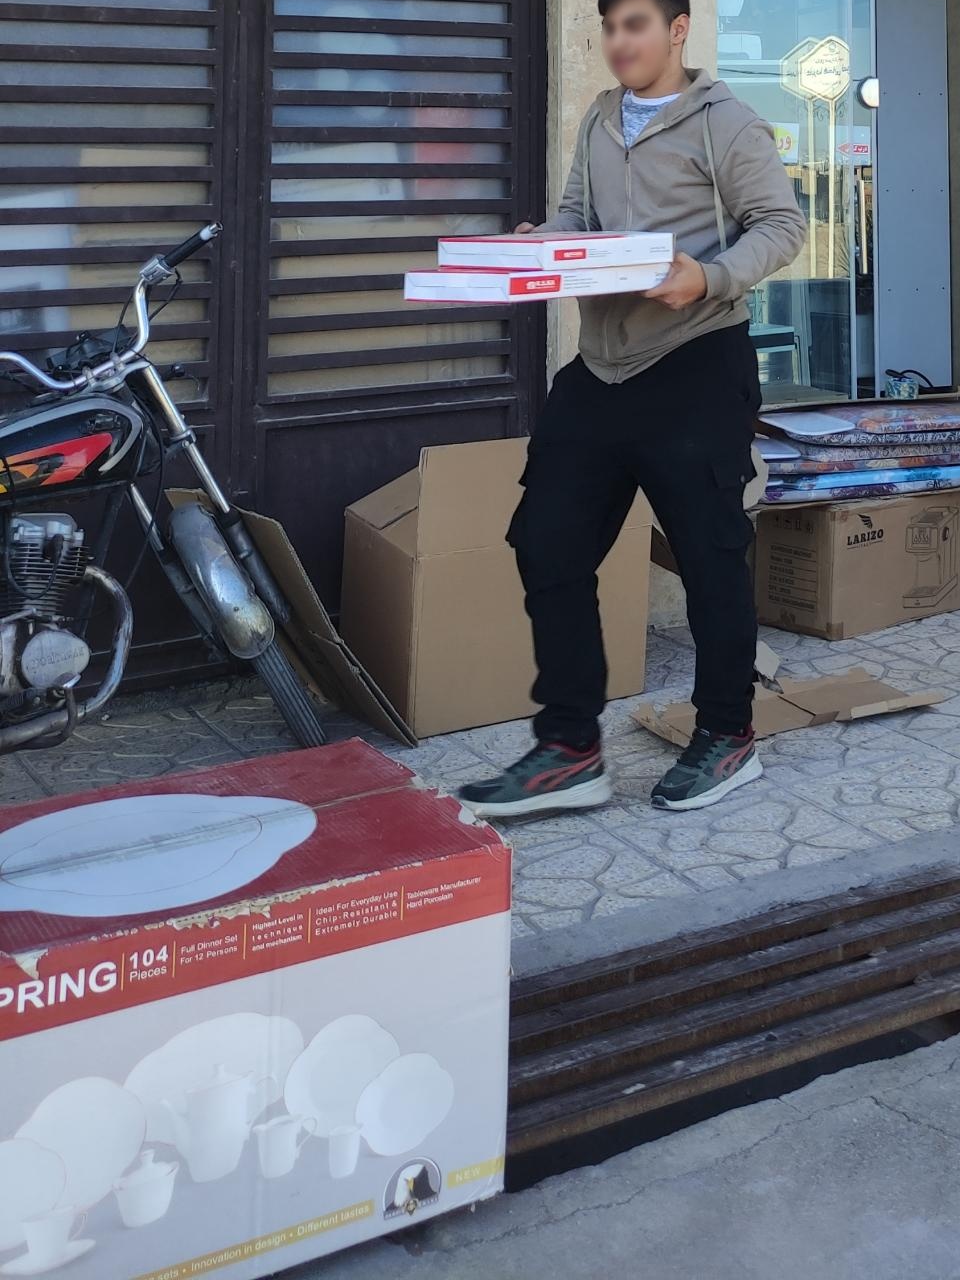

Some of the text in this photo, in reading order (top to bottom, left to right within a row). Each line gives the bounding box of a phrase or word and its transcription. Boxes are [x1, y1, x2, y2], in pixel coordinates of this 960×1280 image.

[847, 528, 884, 546] LARIZO
[406, 876, 481, 899] Tableware Manufacturer
[315, 890, 398, 915] Ideal For Everyday Use
[391, 899, 398, 908] &
[406, 892, 454, 909] Hard Porcelain
[252, 919, 277, 931] Highest
[278, 916, 296, 925] Level
[315, 910, 398, 936] Extremely Durable
[181, 934, 238, 954] Full Dinner Set
[252, 934, 303, 952] and mechanism
[129, 945, 168, 969] 104
[180, 945, 238, 965] For 12 Persons
[129, 965, 167, 982] Pieces
[455, 1167, 481, 1183] NEW
[191, 1248, 242, 1272] Innovation
[244, 1245, 253, 1254] in
[255, 1232, 287, 1251] design
[297, 1215, 338, 1236] Different
[340, 1205, 370, 1221] tastes
